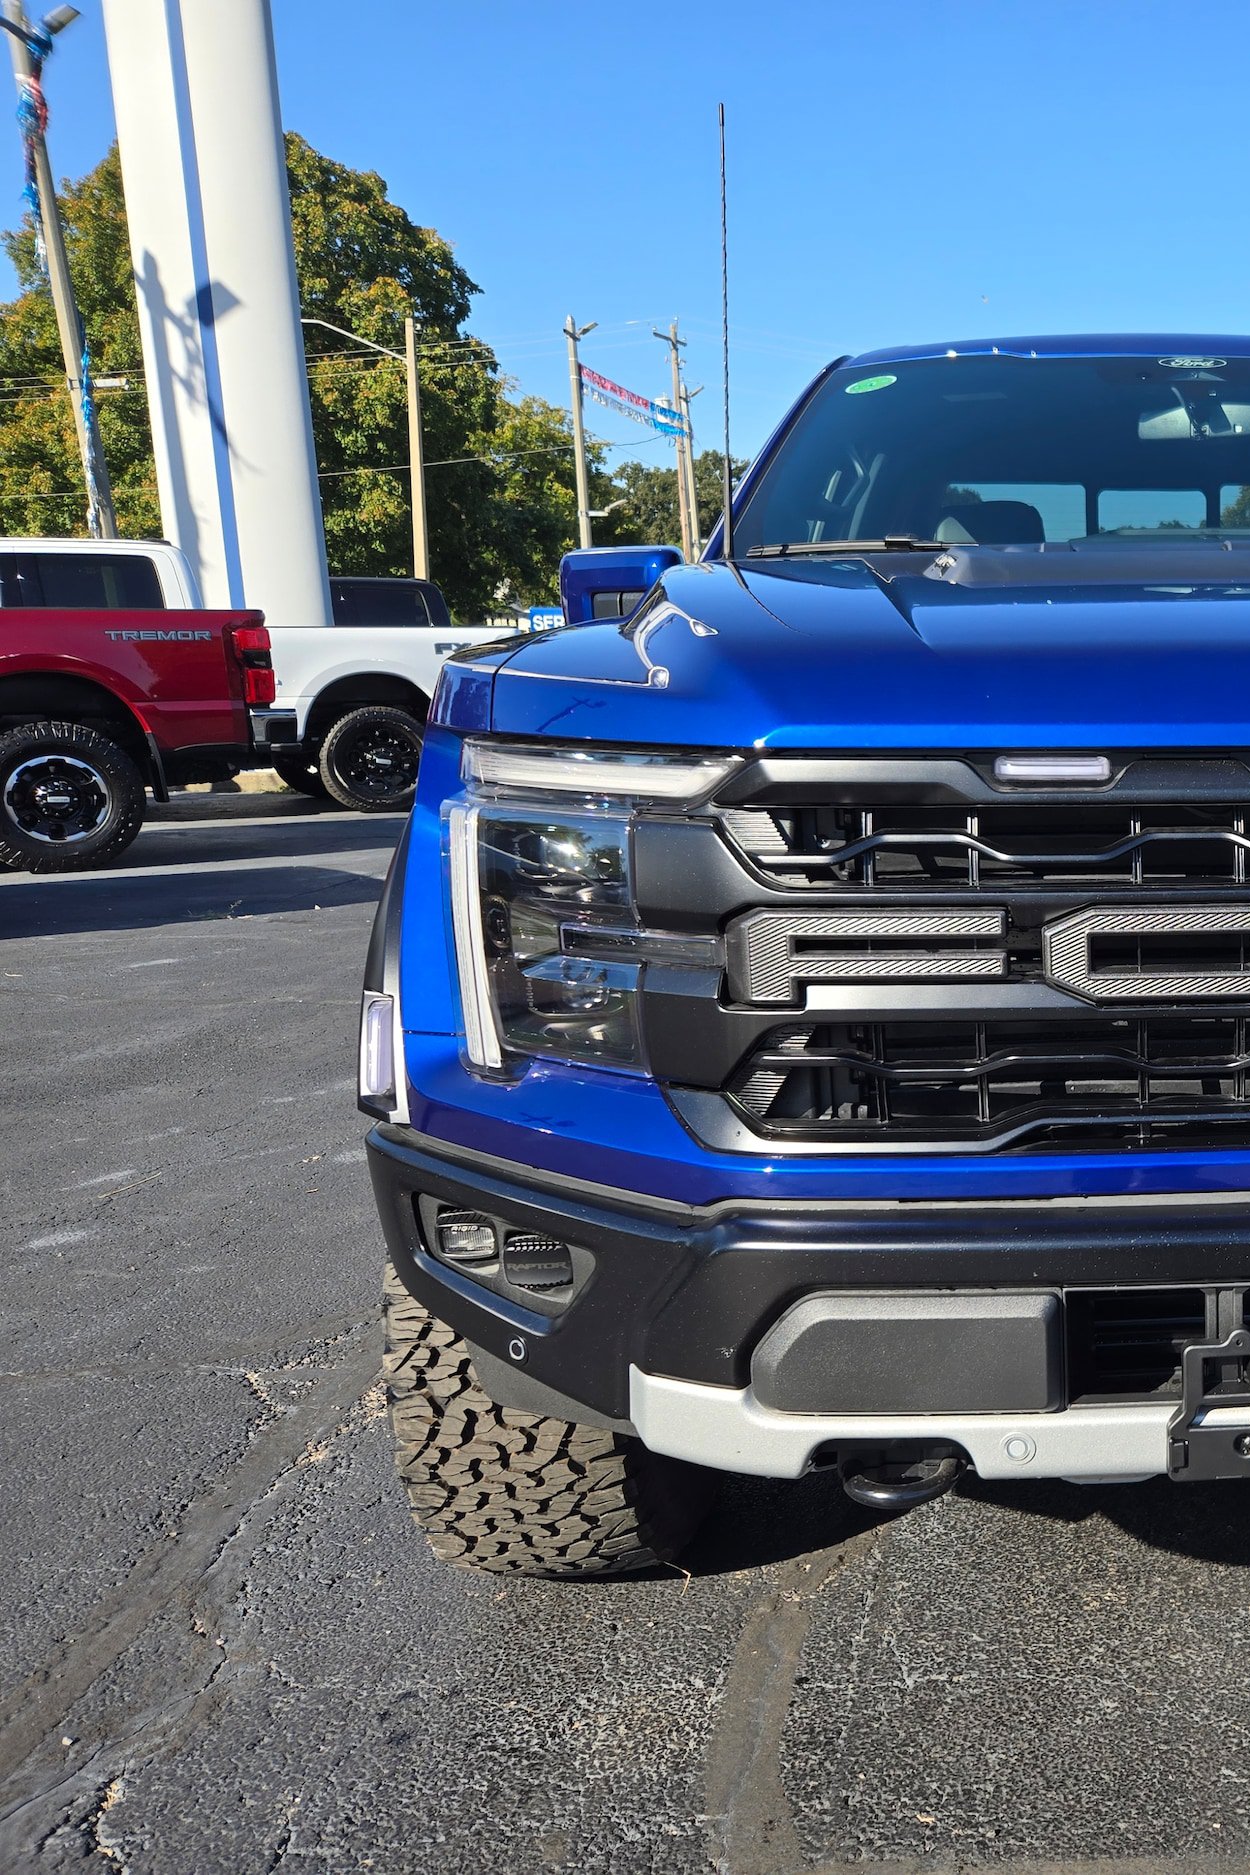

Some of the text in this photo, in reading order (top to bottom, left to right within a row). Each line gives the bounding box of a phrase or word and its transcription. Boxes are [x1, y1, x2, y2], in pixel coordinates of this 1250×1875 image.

[1171, 358, 1215, 366] Ford
[104, 630, 212, 641] TREMOR
[506, 1261, 569, 1272] RAPTOR
